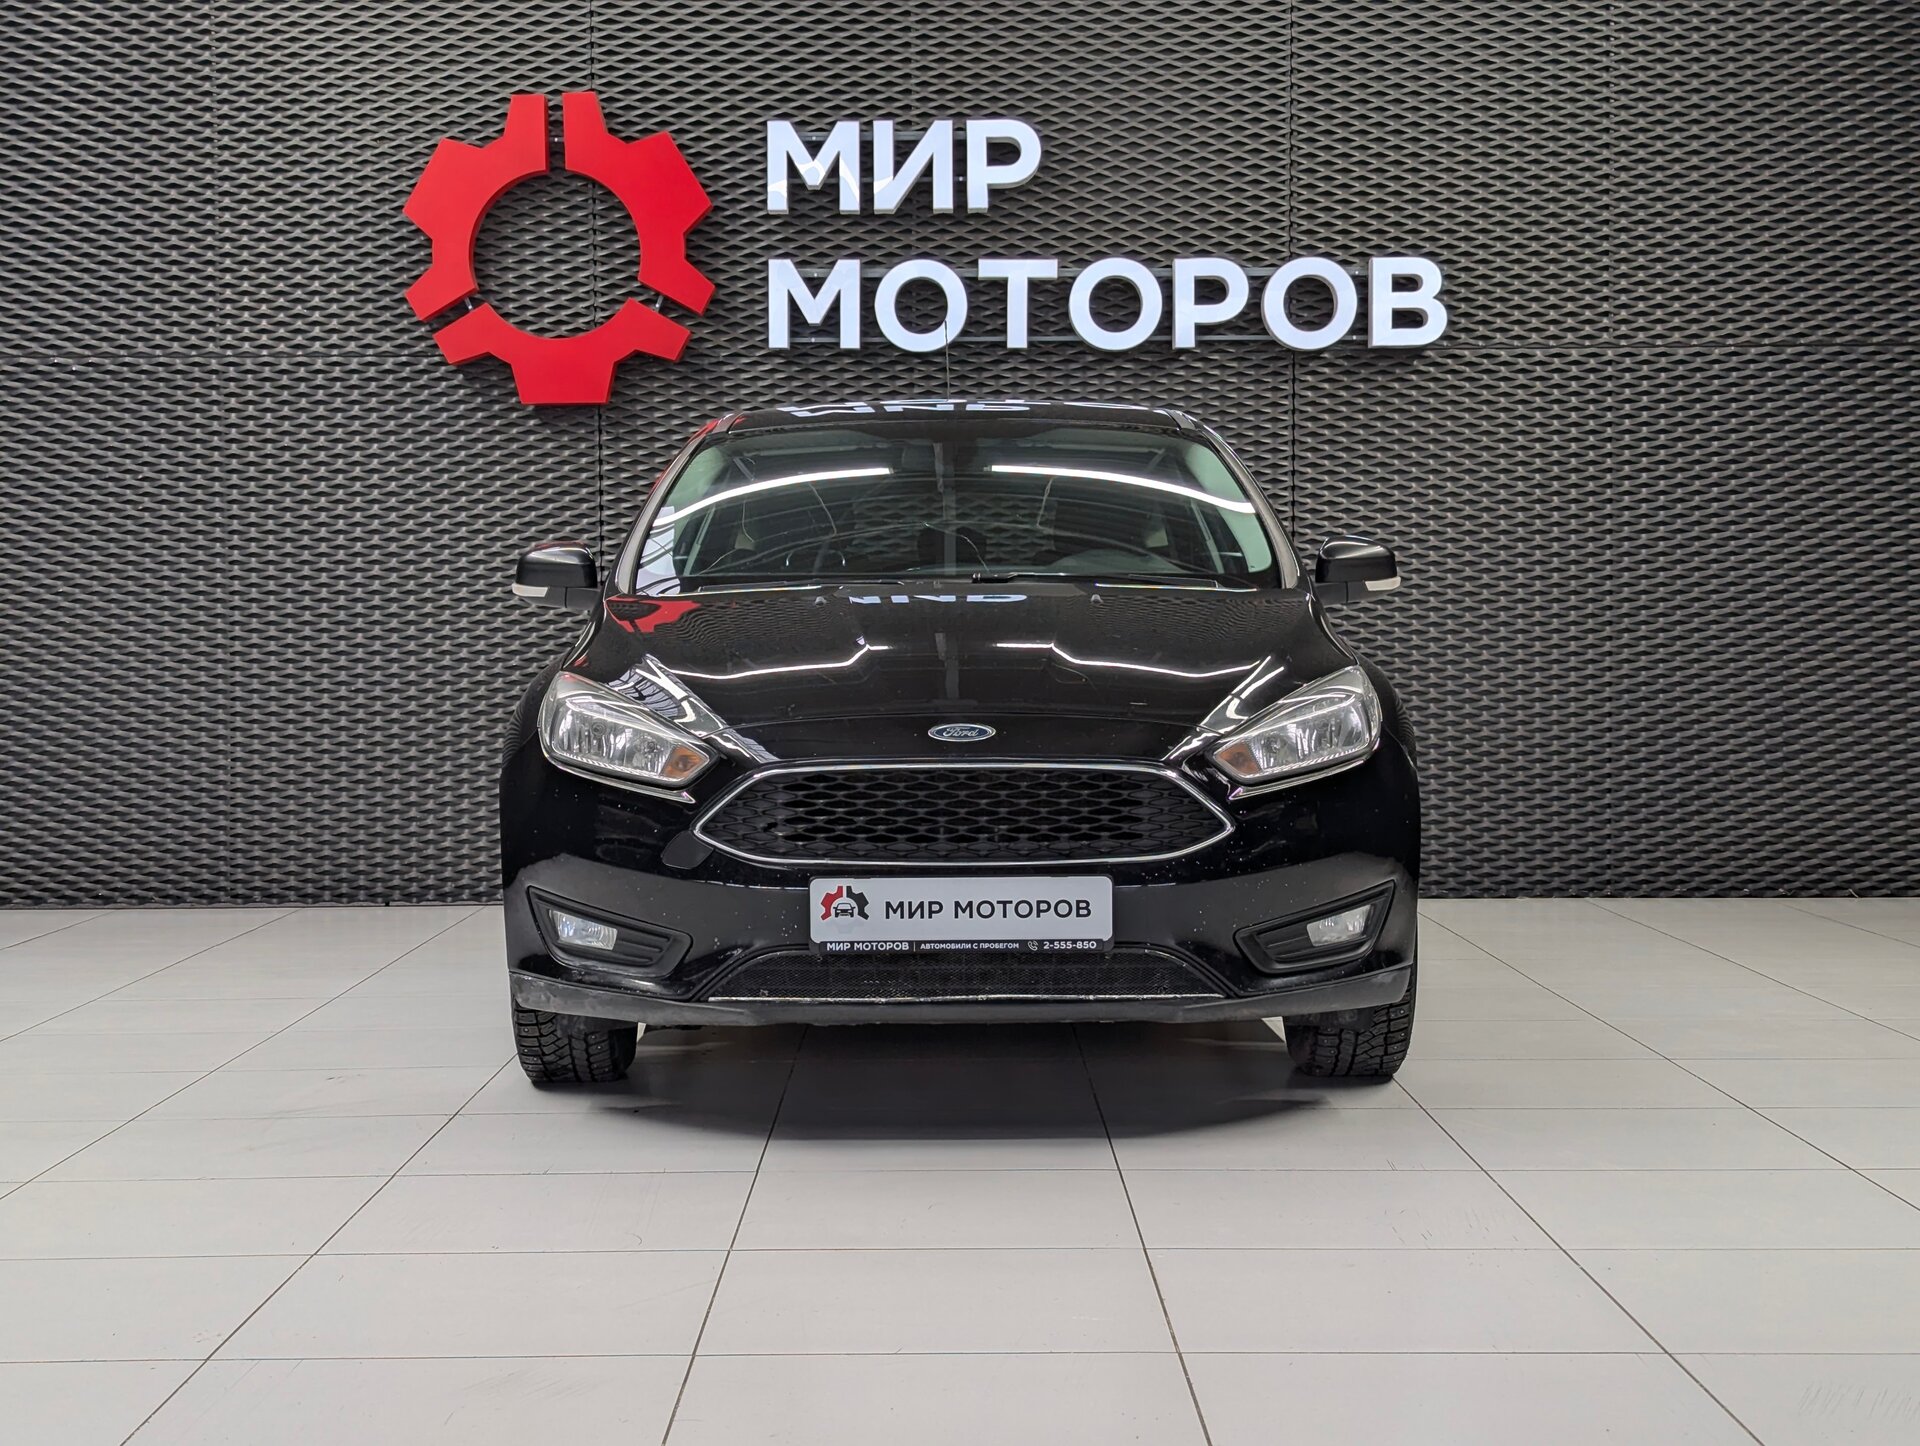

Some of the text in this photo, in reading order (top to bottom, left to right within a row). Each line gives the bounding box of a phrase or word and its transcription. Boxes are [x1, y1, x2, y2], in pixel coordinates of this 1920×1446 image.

[767, 119, 1042, 214] МИР
[767, 256, 1449, 352] МОТОРОВ
[942, 727, 979, 737] Ford
[885, 899, 1092, 919] МИР МОТОРОВ
[826, 942, 851, 951] МИР
[853, 941, 910, 951] МОТОРОВ
[920, 942, 971, 950] АВТОМОБИЛИ
[1043, 940, 1097, 949] 2-555-850
